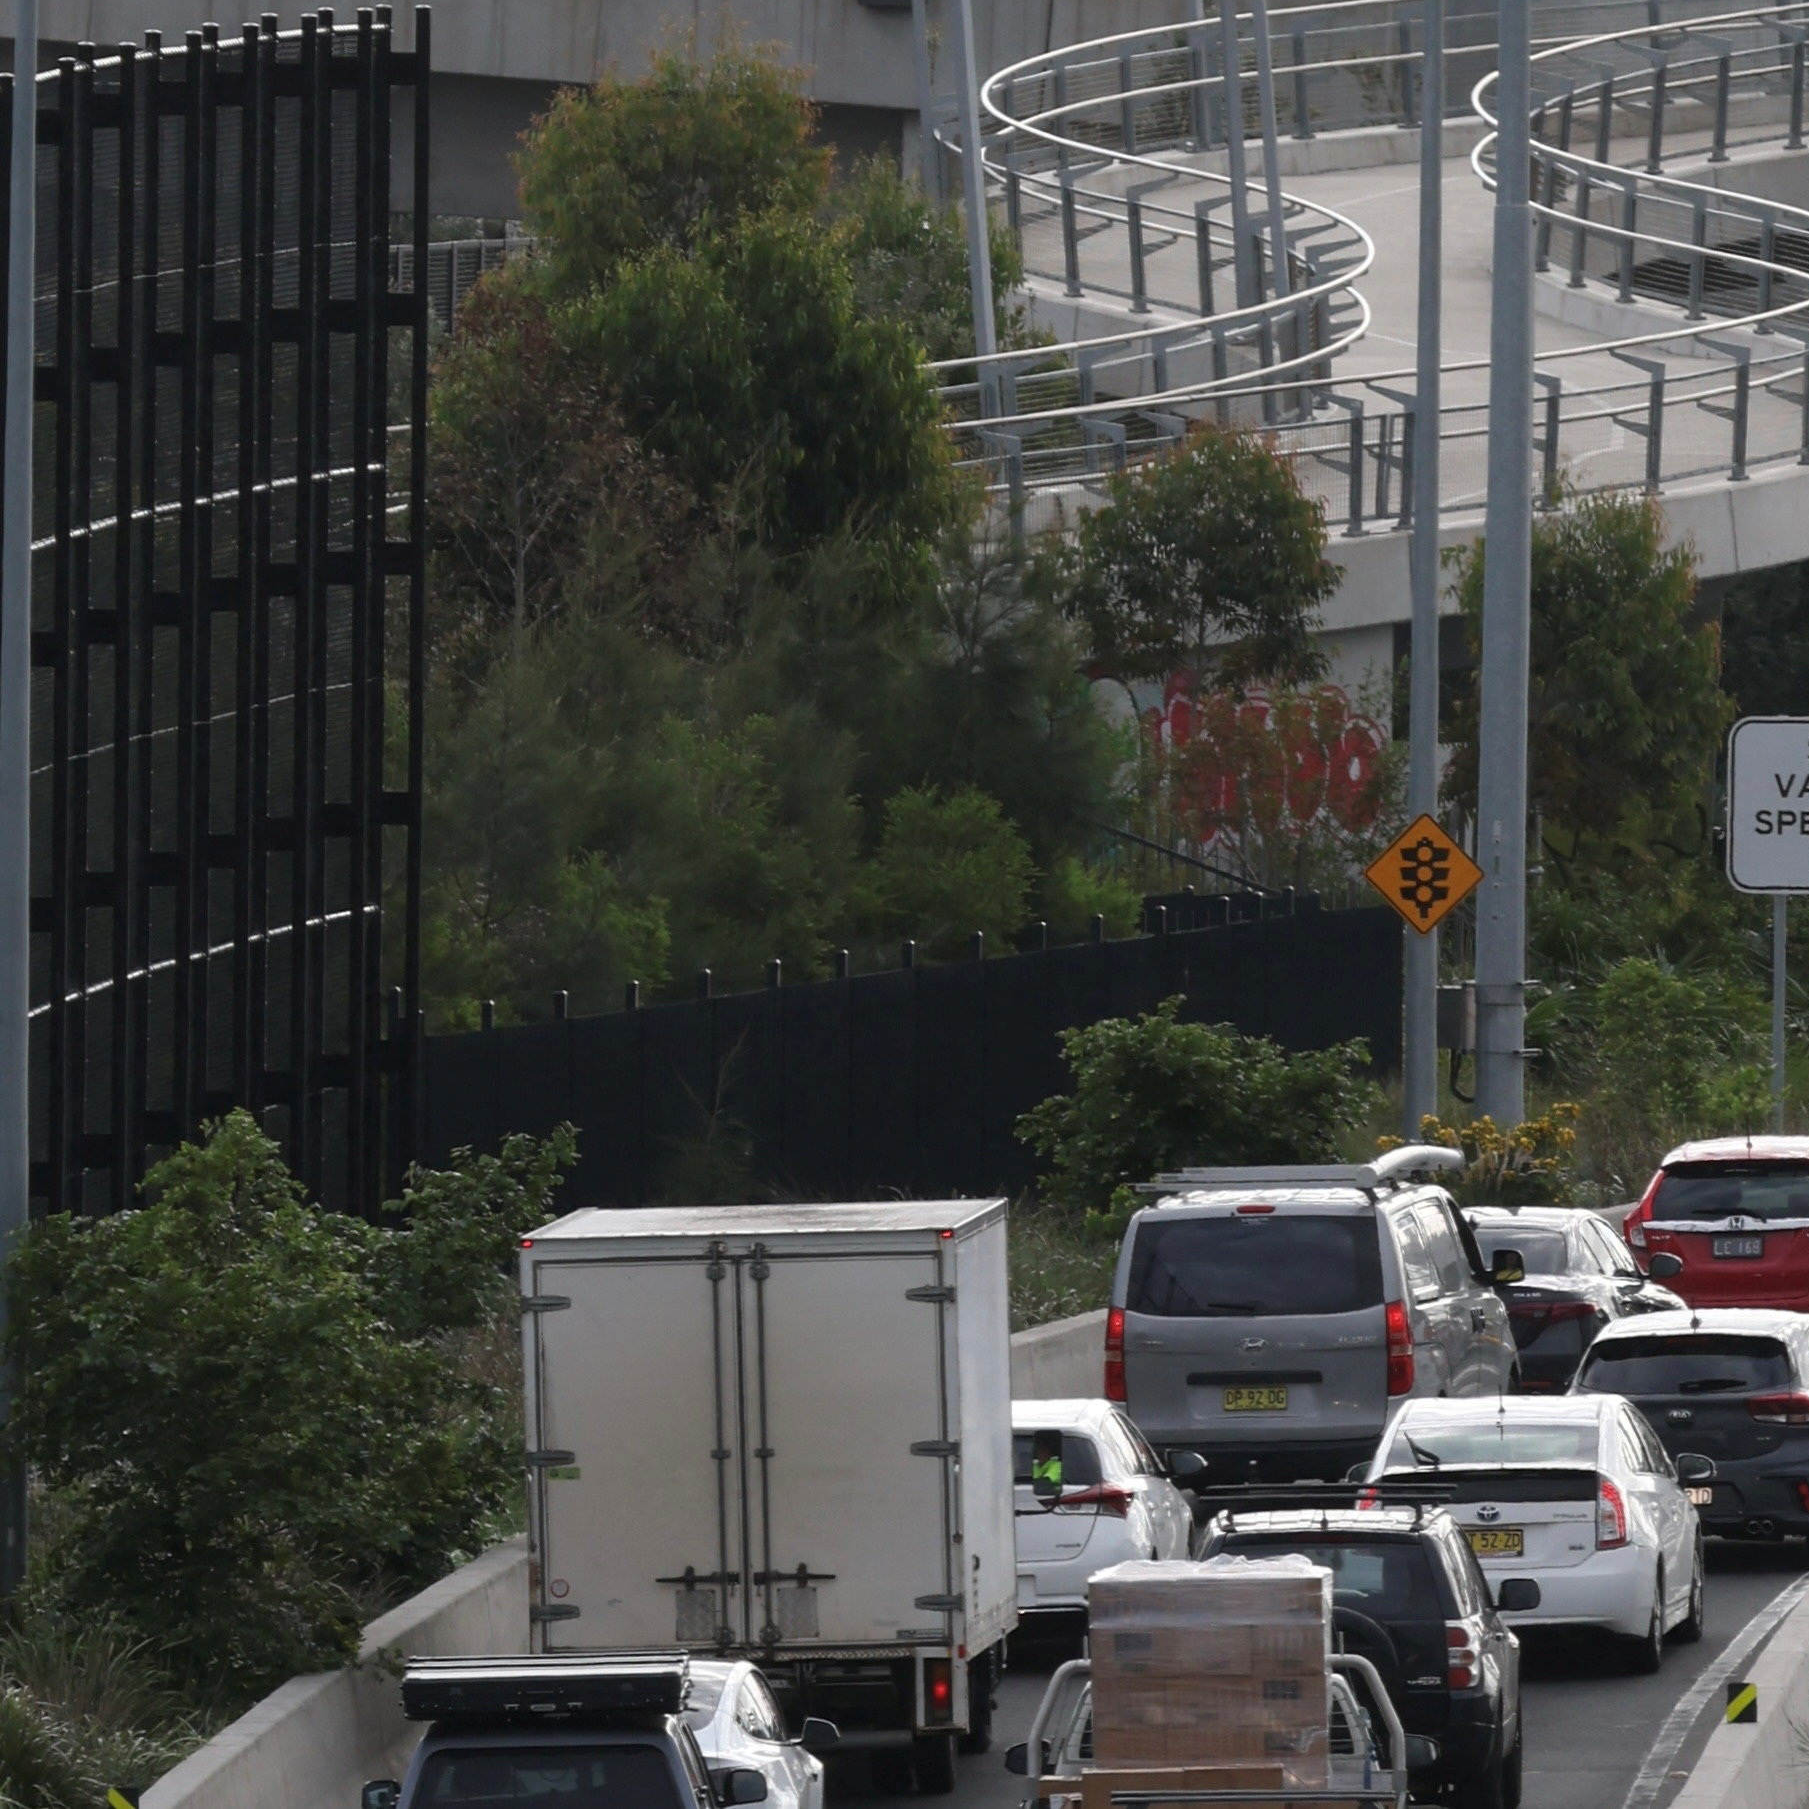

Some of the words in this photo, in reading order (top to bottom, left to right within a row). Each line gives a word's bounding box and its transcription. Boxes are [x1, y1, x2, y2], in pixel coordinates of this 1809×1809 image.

[1226, 1392, 1243, 1404] DP
[1668, 1410, 1692, 1418] KIA
[1482, 1533, 1498, 1549] 52
